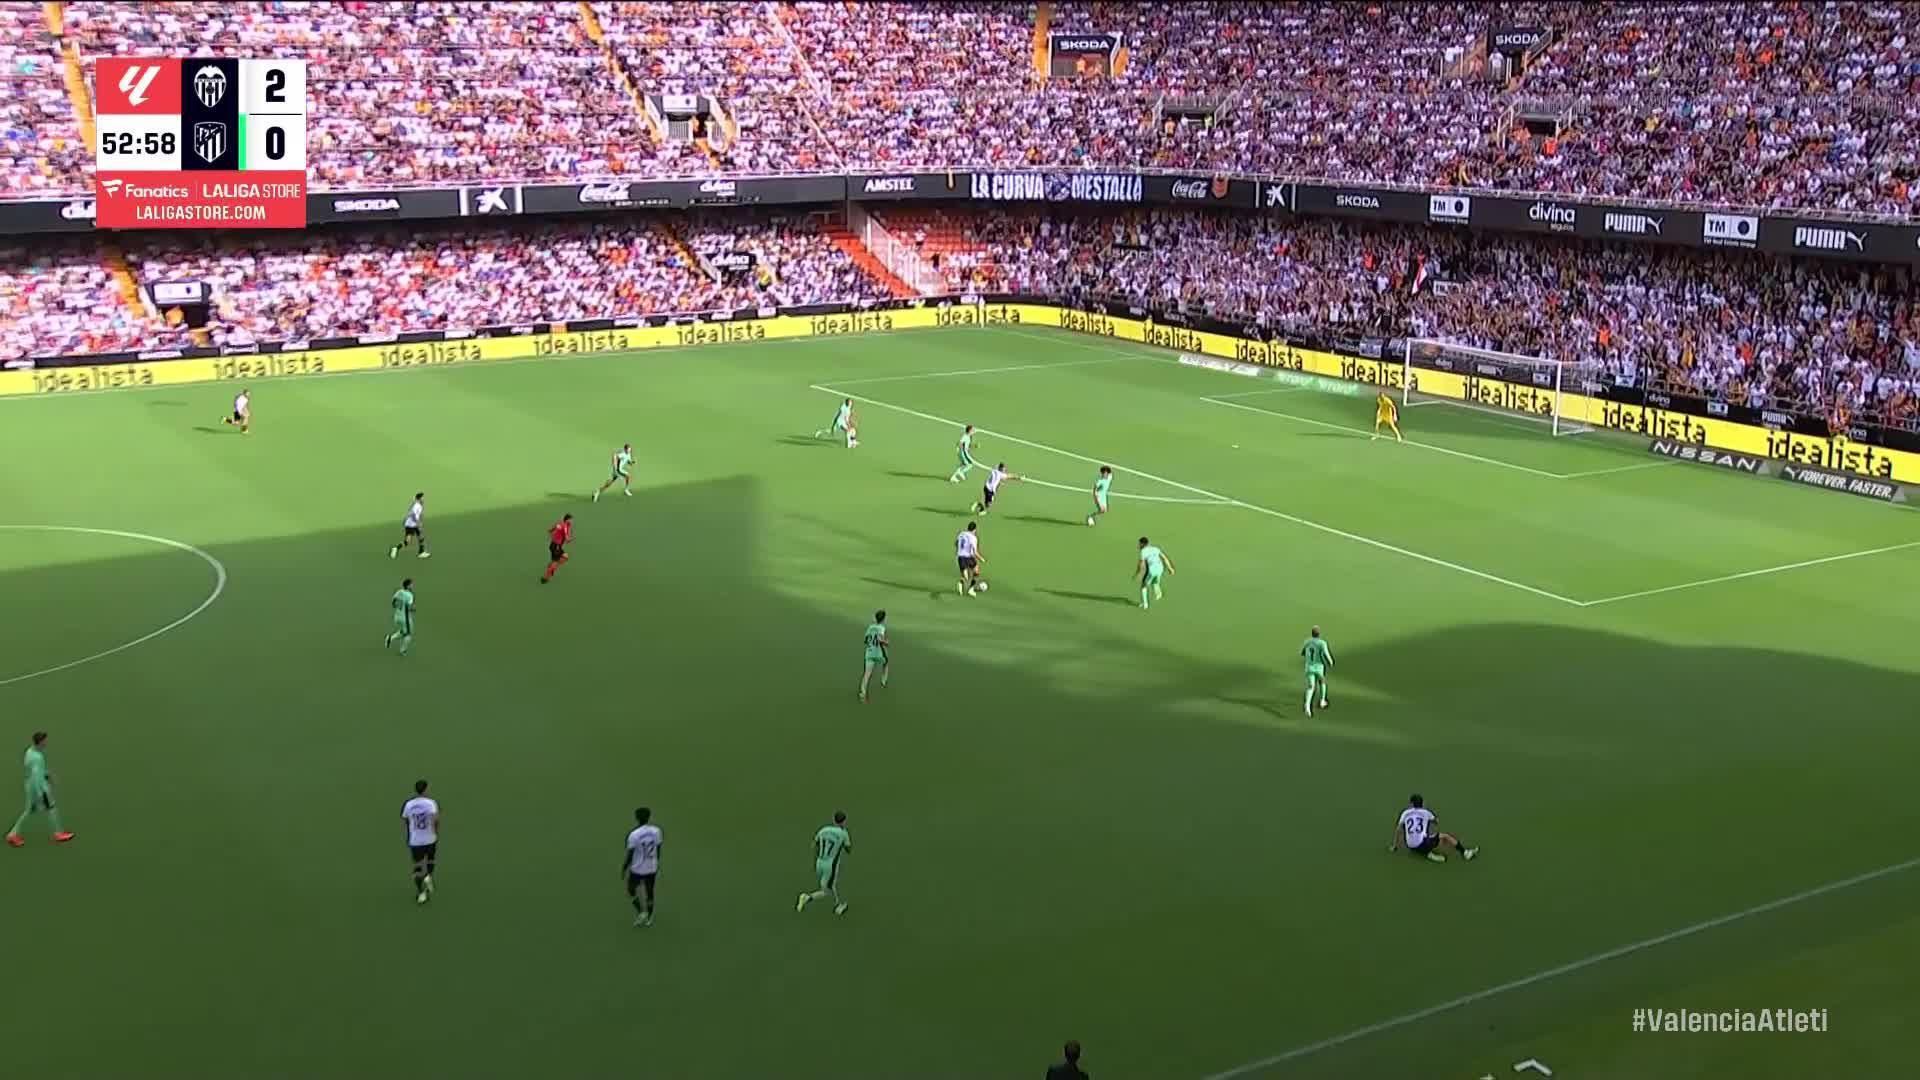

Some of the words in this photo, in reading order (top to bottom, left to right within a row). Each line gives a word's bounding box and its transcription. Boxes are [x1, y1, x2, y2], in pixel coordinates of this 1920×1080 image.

[864, 178, 914, 192] AMSTEL
[970, 173, 990, 199] LA
[991, 174, 1044, 200] CURVA
[1071, 174, 1142, 201] MESTALLA
[1529, 200, 1576, 223] divina
[1604, 213, 1646, 234] PUMA
[1709, 220, 1726, 233] TM
[1795, 226, 1846, 250] PUMA
[810, 311, 893, 337] idealista
[935, 303, 1021, 328] idealista
[1059, 308, 1115, 337] idealista
[533, 331, 629, 357] idealista
[676, 321, 766, 346] idealista
[1143, 319, 1202, 352] idealista
[213, 354, 324, 380] idealista
[380, 341, 482, 368] idealista
[1235, 338, 1303, 371] idealista
[33, 367, 153, 392] idealista
[1602, 400, 1707, 443] idealista
[1651, 439, 1759, 472] NISSAN
[1766, 430, 1893, 479] idealista
[1797, 468, 1847, 490] FOREVER.
[1848, 480, 1893, 499] FASTER.
[411, 813, 426, 830] 18
[1406, 817, 1424, 834] 23
[641, 839, 656, 859] 12
[822, 839, 835, 859] 17
